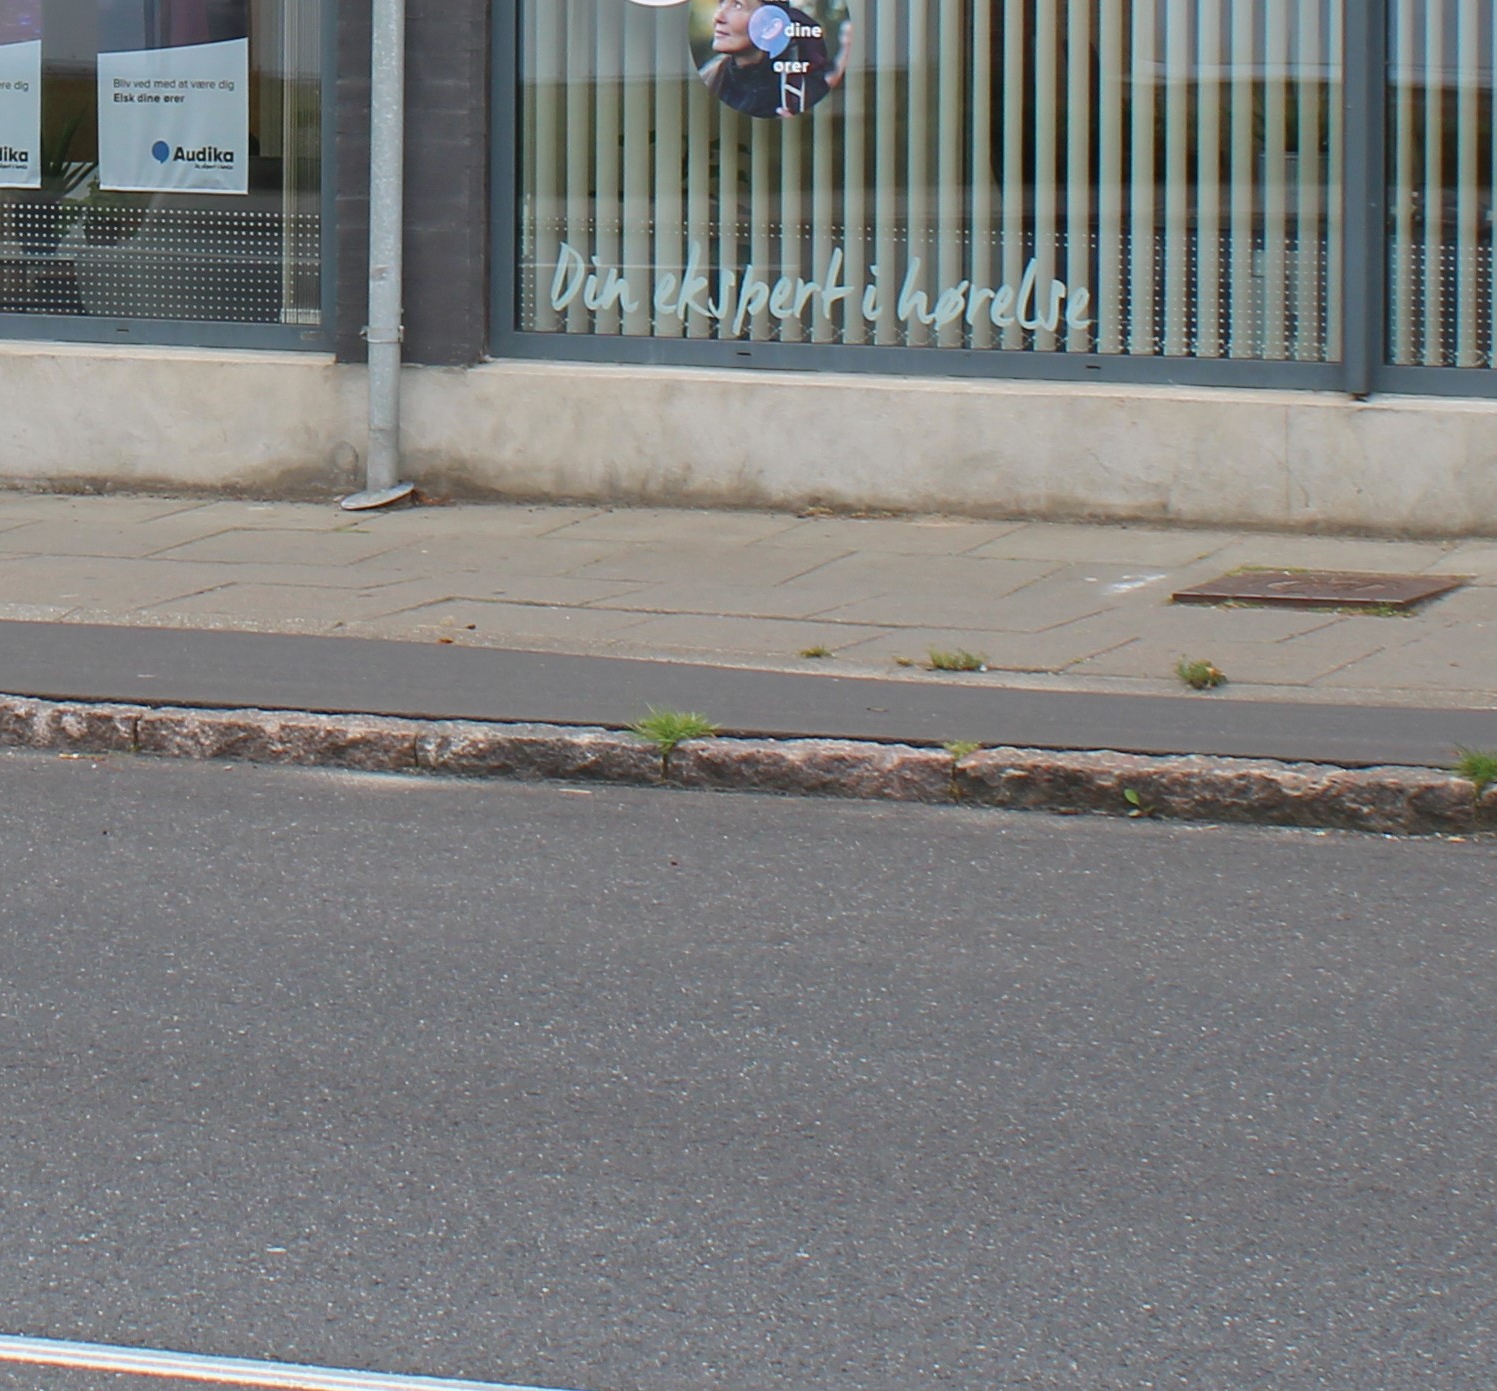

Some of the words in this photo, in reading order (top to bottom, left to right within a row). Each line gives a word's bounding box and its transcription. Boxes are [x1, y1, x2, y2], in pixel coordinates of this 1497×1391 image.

[784, 22, 822, 38] dine
[773, 61, 810, 73] ører
[14, 81, 29, 92] dig
[173, 146, 234, 162] Audika
[550, 242, 638, 312] Din
[653, 240, 854, 336] ekspert
[862, 264, 883, 322] i
[897, 256, 1092, 330] hørelse
